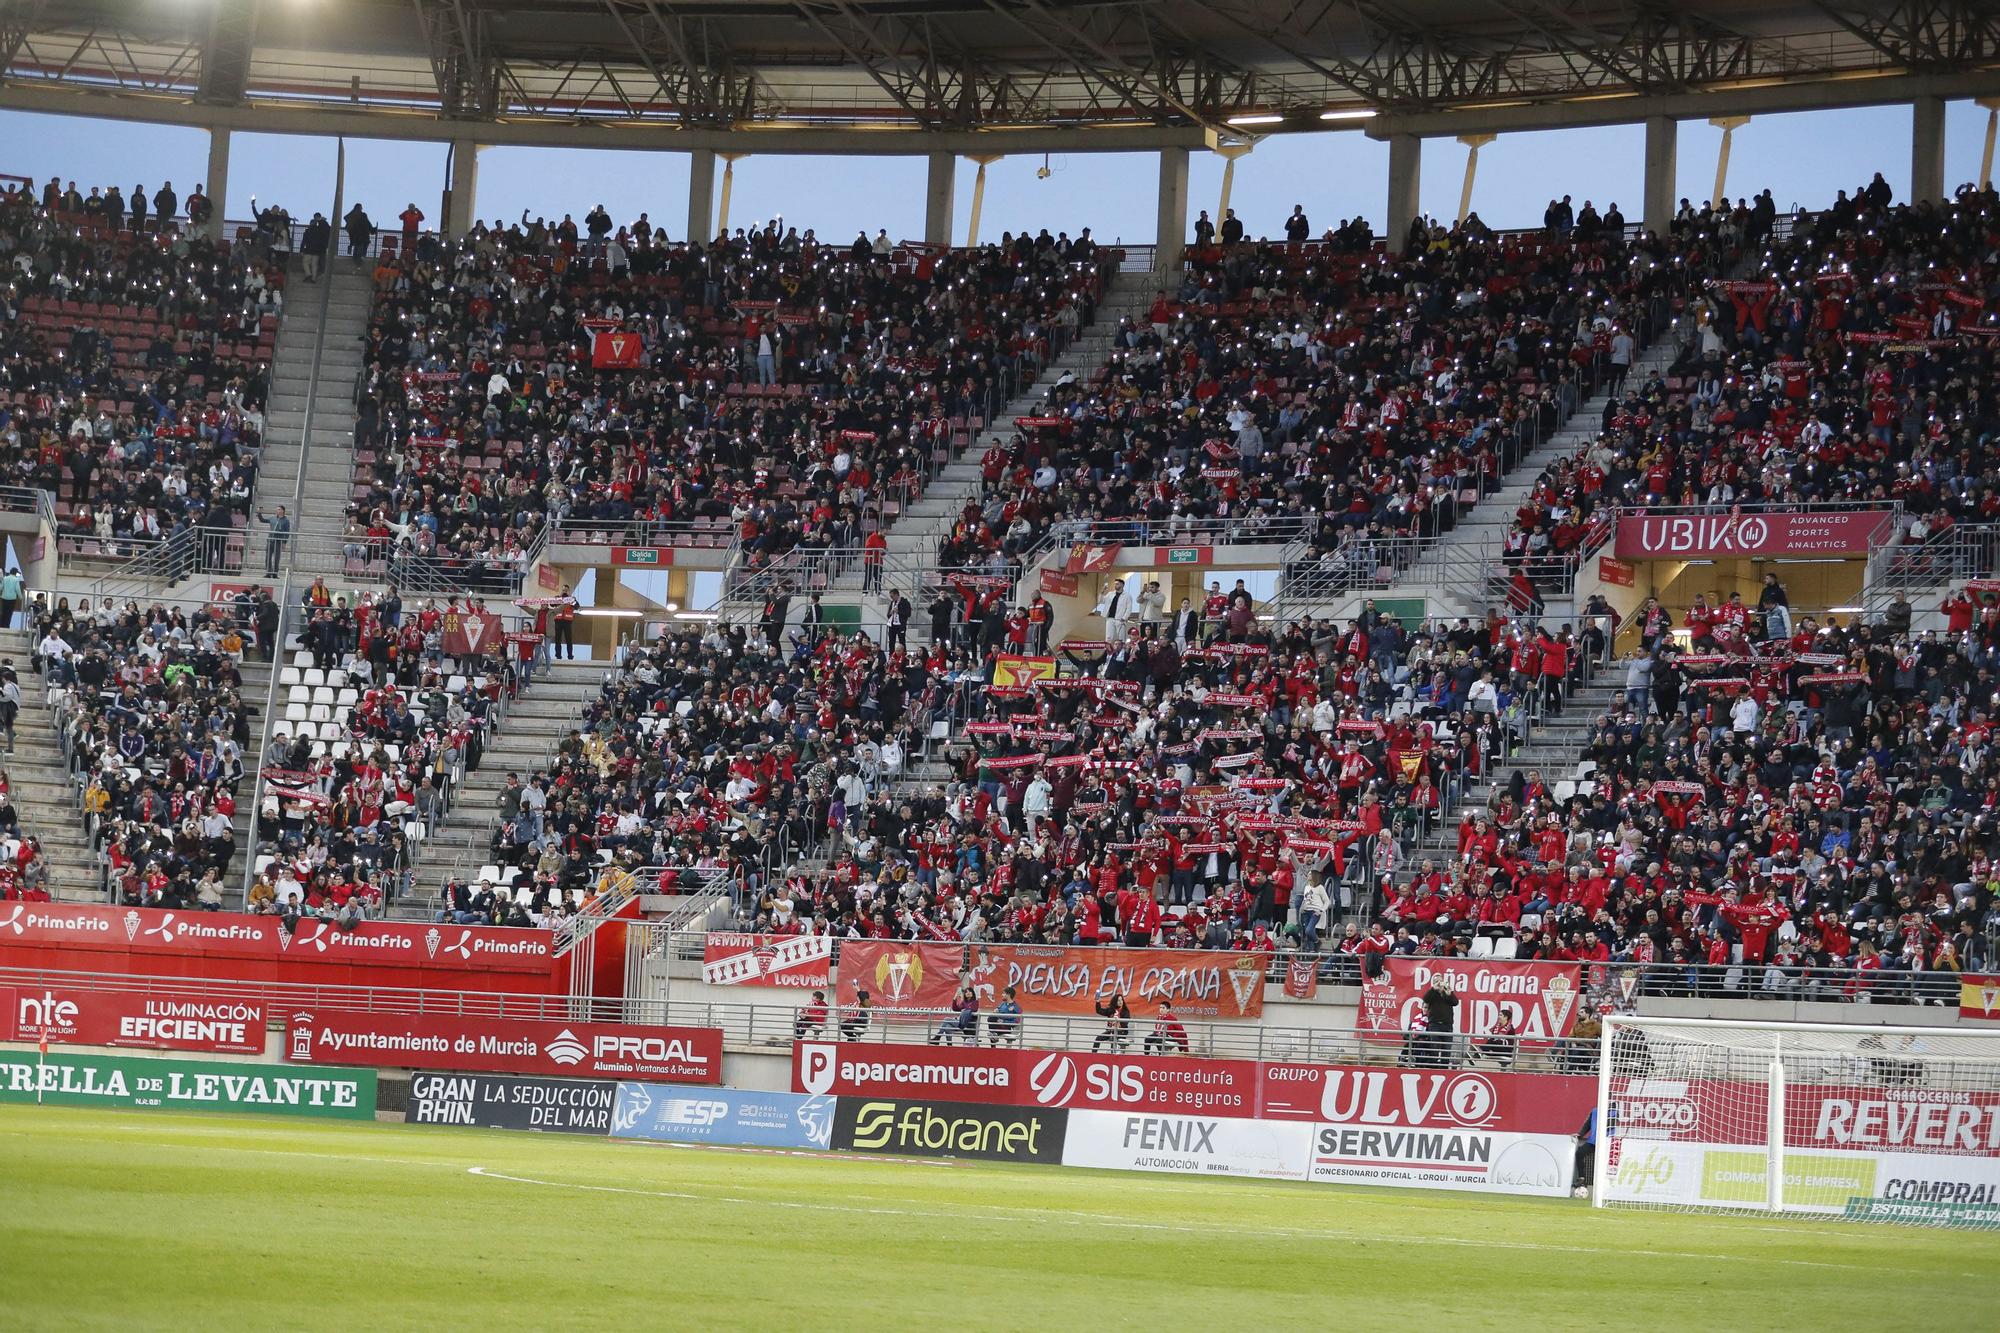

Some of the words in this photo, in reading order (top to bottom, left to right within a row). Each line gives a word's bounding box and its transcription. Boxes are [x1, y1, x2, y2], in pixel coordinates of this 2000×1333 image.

[1789, 516, 1849, 525] ADVANCED
[1788, 528, 1831, 536] SPORTS
[1786, 540, 1847, 549] ANALYTICS
[631, 550, 652, 558] Salida
[1171, 550, 1193, 558] Salida
[27, 914, 109, 931] PrimaFrio
[177, 921, 263, 941] PrimaFrio
[330, 931, 412, 949] PrimaFrio
[474, 938, 547, 956] PrimaFrio
[707, 935, 754, 947] BENDITA
[774, 973, 829, 988] LOCURA
[1008, 961, 1091, 998] PIENSA
[1099, 964, 1136, 998] EN
[1140, 965, 1221, 1003] GRANA
[1474, 969, 1539, 995] Grana
[1363, 998, 1397, 1009] HURRA
[1378, 992, 1397, 1000] Grana
[19, 991, 79, 1026] nte
[145, 1000, 260, 1022] ILUMINACIÓN
[1401, 996, 1548, 1042] CURRA
[19, 1025, 37, 1033] MORE
[39, 1026, 57, 1034] TAN
[58, 1027, 78, 1035] LIGHT
[119, 1016, 246, 1043] EFICIENTE
[319, 1027, 449, 1051] Ayuntamiento
[454, 1035, 475, 1053] de
[480, 1036, 537, 1056] Murcia
[593, 1035, 708, 1063] IPROAL
[593, 1061, 633, 1073] Aluminio
[635, 1064, 669, 1074] Ventanas
[670, 1065, 677, 1074] &
[678, 1065, 708, 1076] Puertas
[841, 1061, 1009, 1086] aparcamurcia
[1150, 1067, 1234, 1085] correduría
[1268, 1067, 1319, 1082] GRUPO
[136, 1077, 164, 1092] DE
[167, 1072, 358, 1108] LEVANTE
[413, 1076, 477, 1102] GRAN
[1085, 1063, 1144, 1102] SIS
[484, 1084, 506, 1103] LA
[511, 1084, 613, 1108] SEDUCCIÓN
[1150, 1087, 1168, 1102] de
[1176, 1091, 1242, 1109] seguros
[1884, 1089, 1970, 1104] CARROCERIAS
[530, 1106, 563, 1126] DEL
[568, 1108, 609, 1129] MAR
[678, 1099, 729, 1126] ESP
[738, 1104, 759, 1117] 20
[1616, 1100, 1694, 1126] LPOZO
[653, 1124, 711, 1134] SOLUTIONS
[897, 1106, 1042, 1155] fibranet
[1123, 1117, 1218, 1154] FENIX
[1317, 1128, 1492, 1163] SERVIMAN
[1134, 1156, 1199, 1170] AUTOMOCIÓN
[1206, 1163, 1229, 1171] IBERIA
[1314, 1166, 1379, 1178] CONCESIONARIO
[1380, 1170, 1412, 1180] OFICIAL
[1455, 1174, 1487, 1184] MURCIA
[1714, 1170, 1802, 1186] COMPAROS
[1804, 1175, 1861, 1189] EMPRESA
[1870, 1203, 1951, 1218] ESTRELLA
